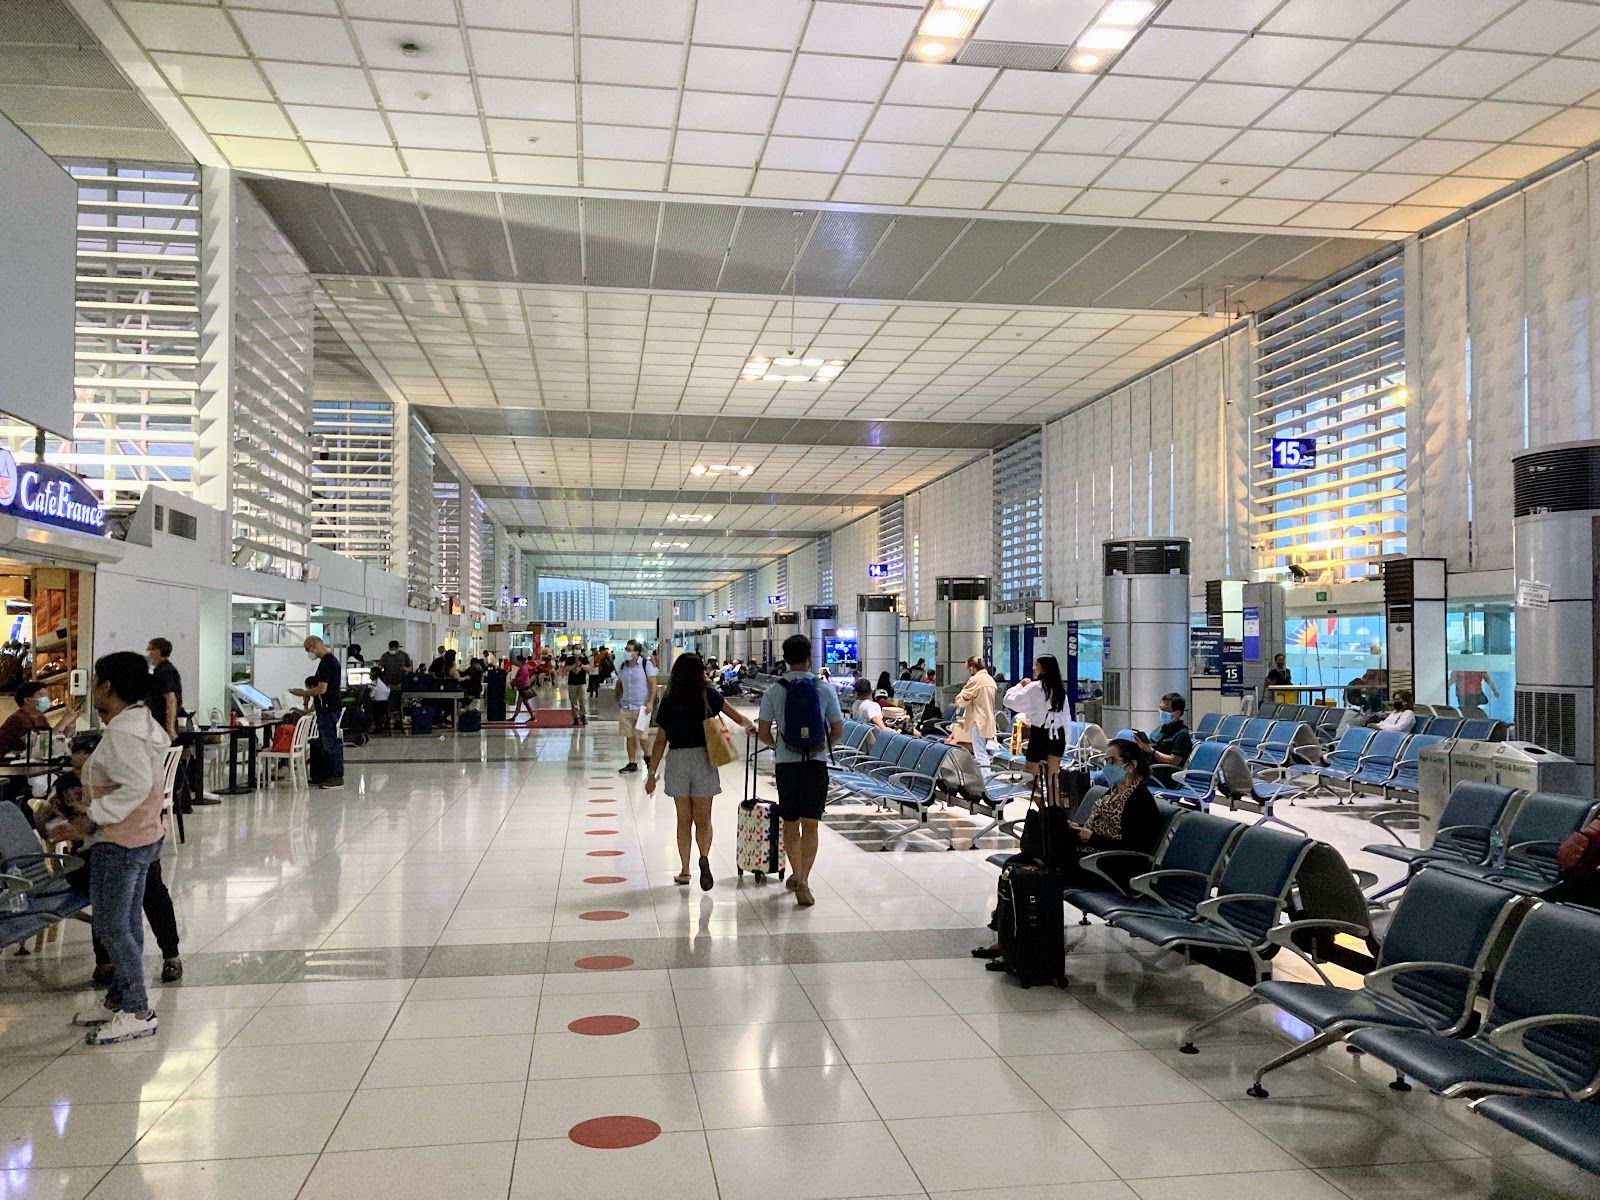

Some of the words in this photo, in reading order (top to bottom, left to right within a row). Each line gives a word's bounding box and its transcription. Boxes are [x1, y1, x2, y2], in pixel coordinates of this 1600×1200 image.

[1275, 441, 1300, 465] 15
[870, 565, 881, 576] 14
[1225, 669, 1238, 679] 15
